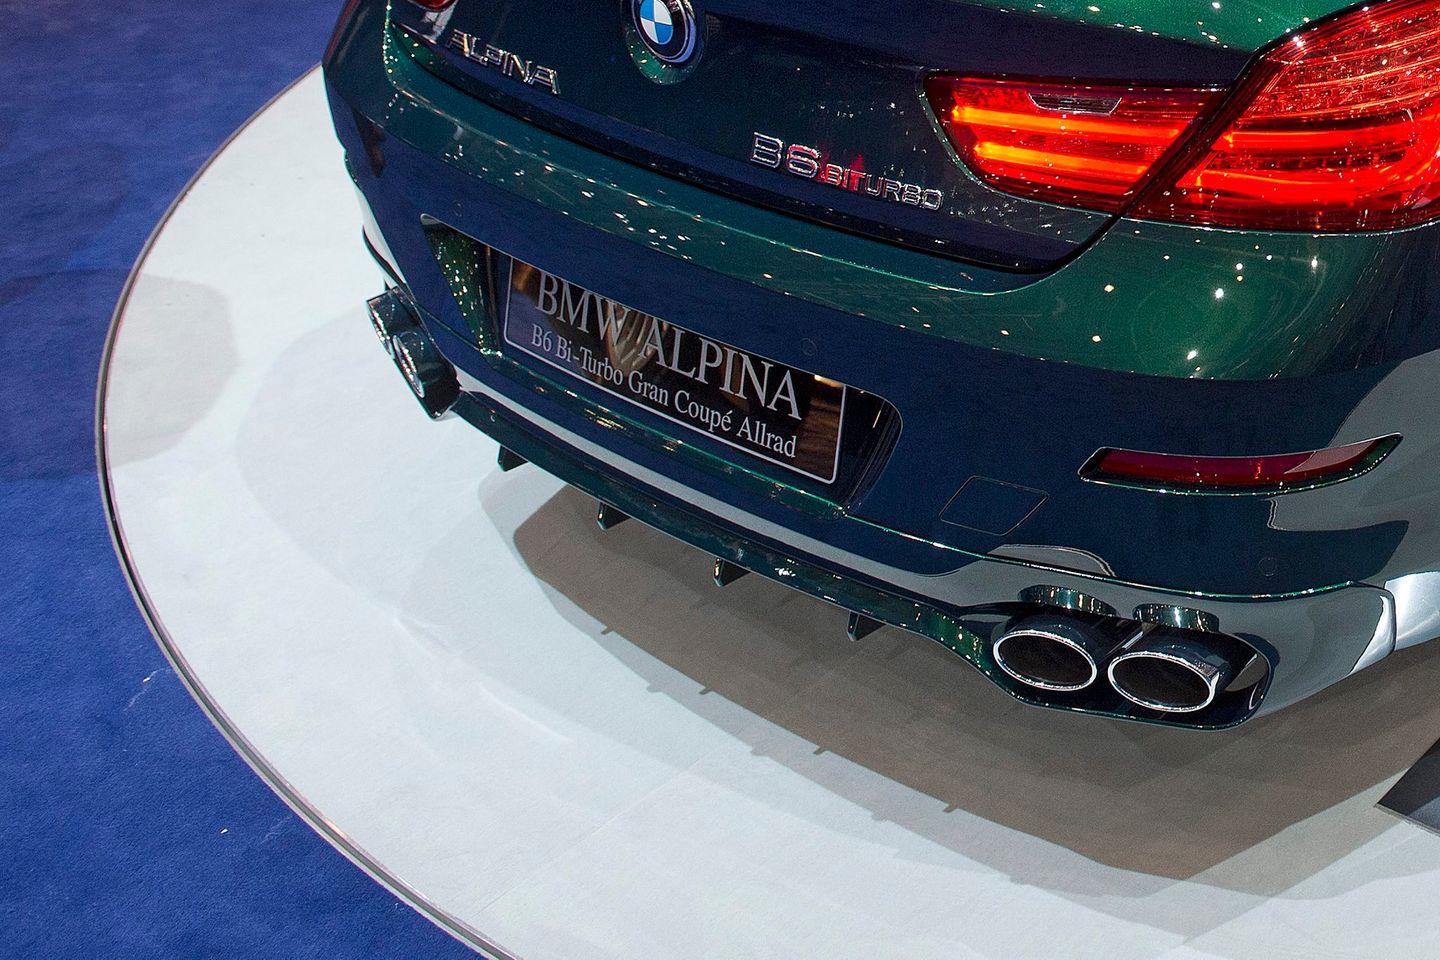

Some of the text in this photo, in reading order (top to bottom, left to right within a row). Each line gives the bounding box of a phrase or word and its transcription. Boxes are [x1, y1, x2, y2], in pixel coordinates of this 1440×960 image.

[446, 28, 560, 95] ALPINA
[750, 131, 944, 211] B6 BITURBO
[531, 324, 797, 458] B6 Bi-Turbo Gran Coupé Allrad
[535, 269, 802, 420] BMW ALPINA
